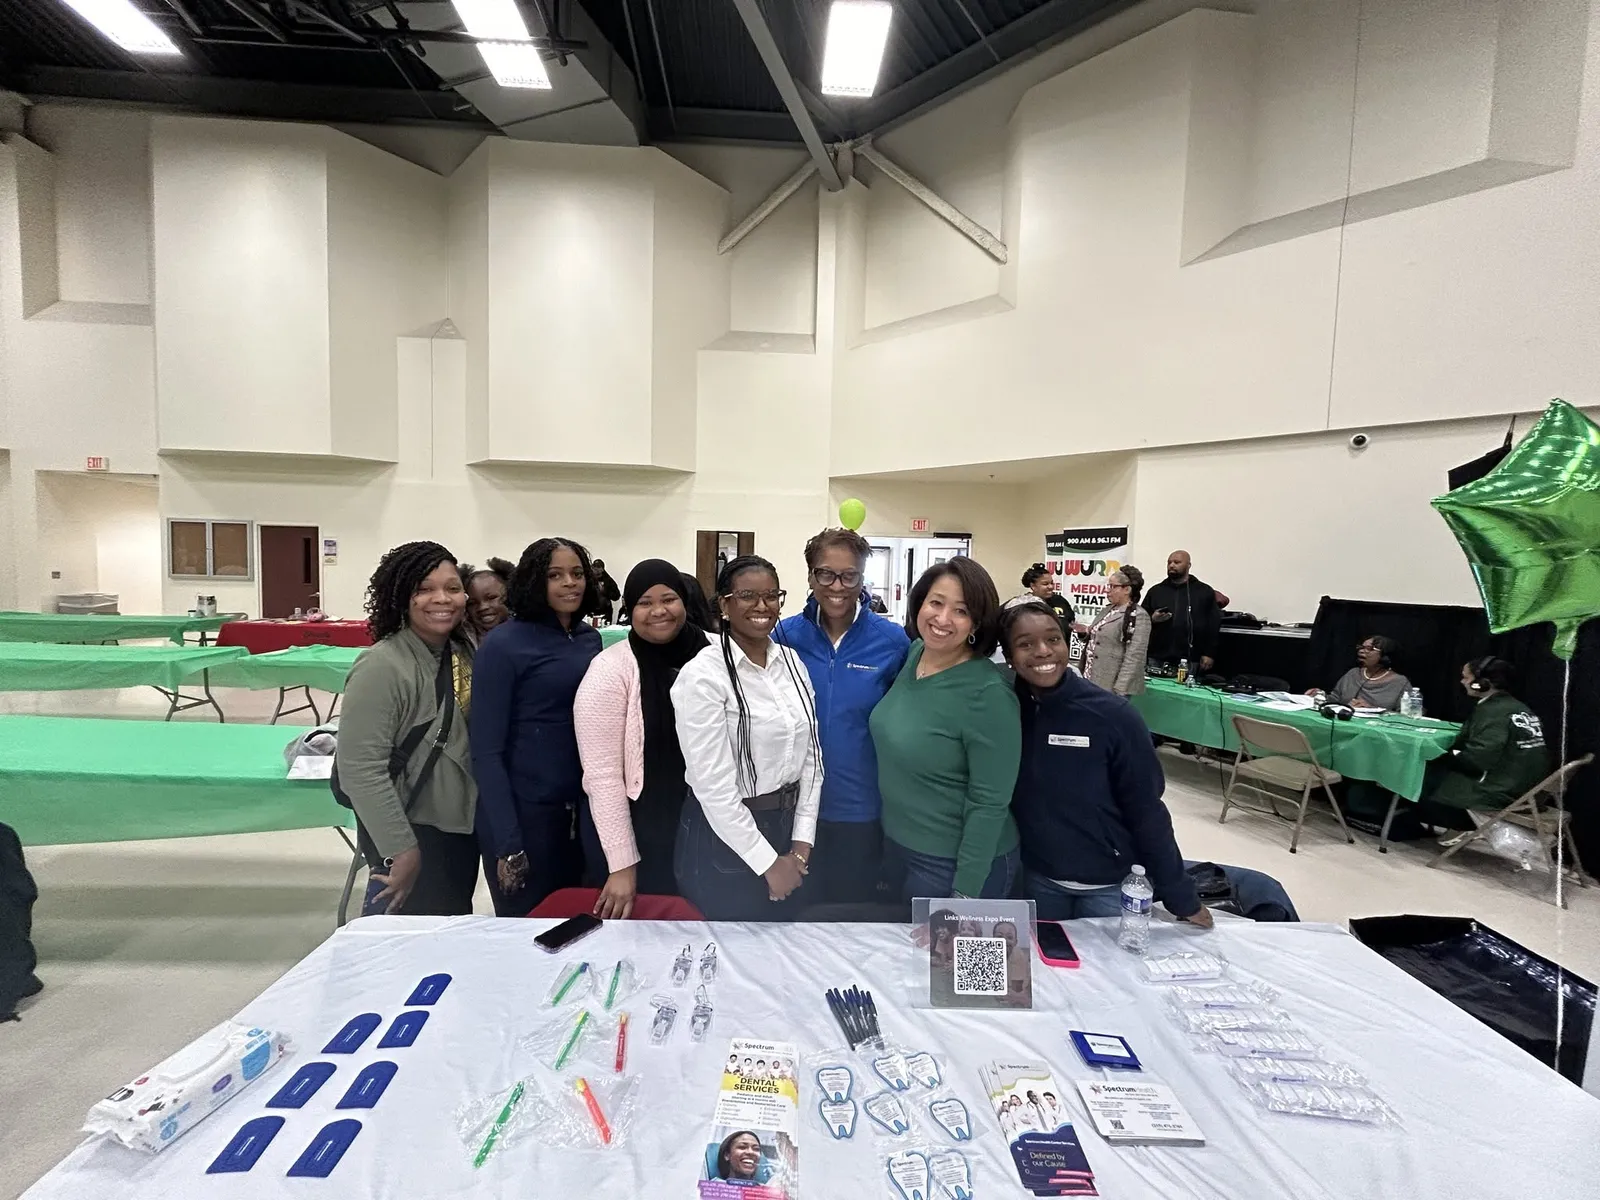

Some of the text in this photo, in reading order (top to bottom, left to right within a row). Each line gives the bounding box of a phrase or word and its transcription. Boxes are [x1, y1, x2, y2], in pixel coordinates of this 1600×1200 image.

[87, 457, 102, 468] EXIT
[912, 519, 926, 530] EXIT
[1074, 594, 1105, 605] THAT
[1073, 605, 1102, 616] ATTE
[984, 916, 999, 924] Expo
[740, 1077, 777, 1087] DENTAL
[733, 1083, 779, 1094] SERVICES
[1030, 1152, 1065, 1161] Defined by
